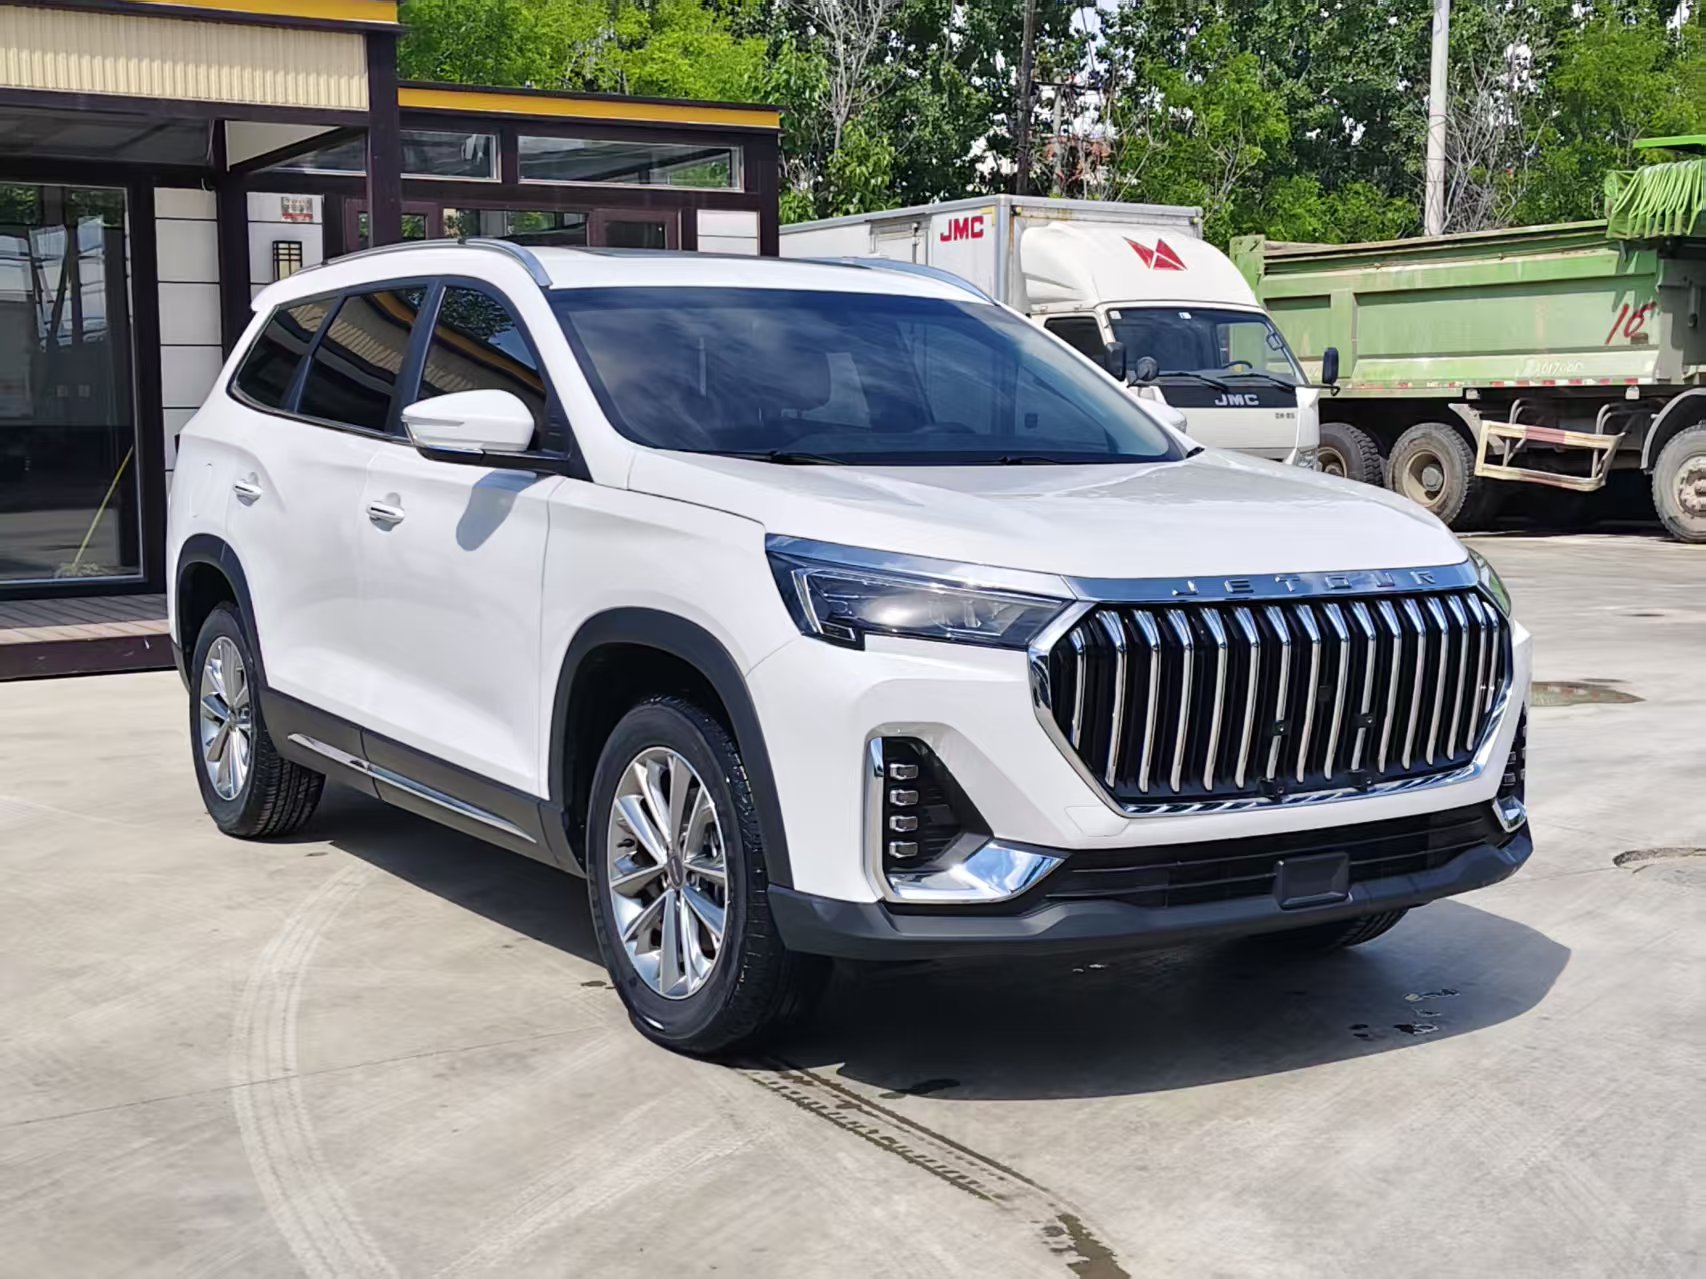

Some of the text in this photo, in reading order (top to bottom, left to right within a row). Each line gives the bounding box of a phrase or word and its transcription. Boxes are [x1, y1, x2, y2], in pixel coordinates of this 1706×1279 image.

[940, 215, 984, 241] JMC
[1215, 394, 1259, 406] JMC
[1172, 570, 1436, 596] JETOUR
